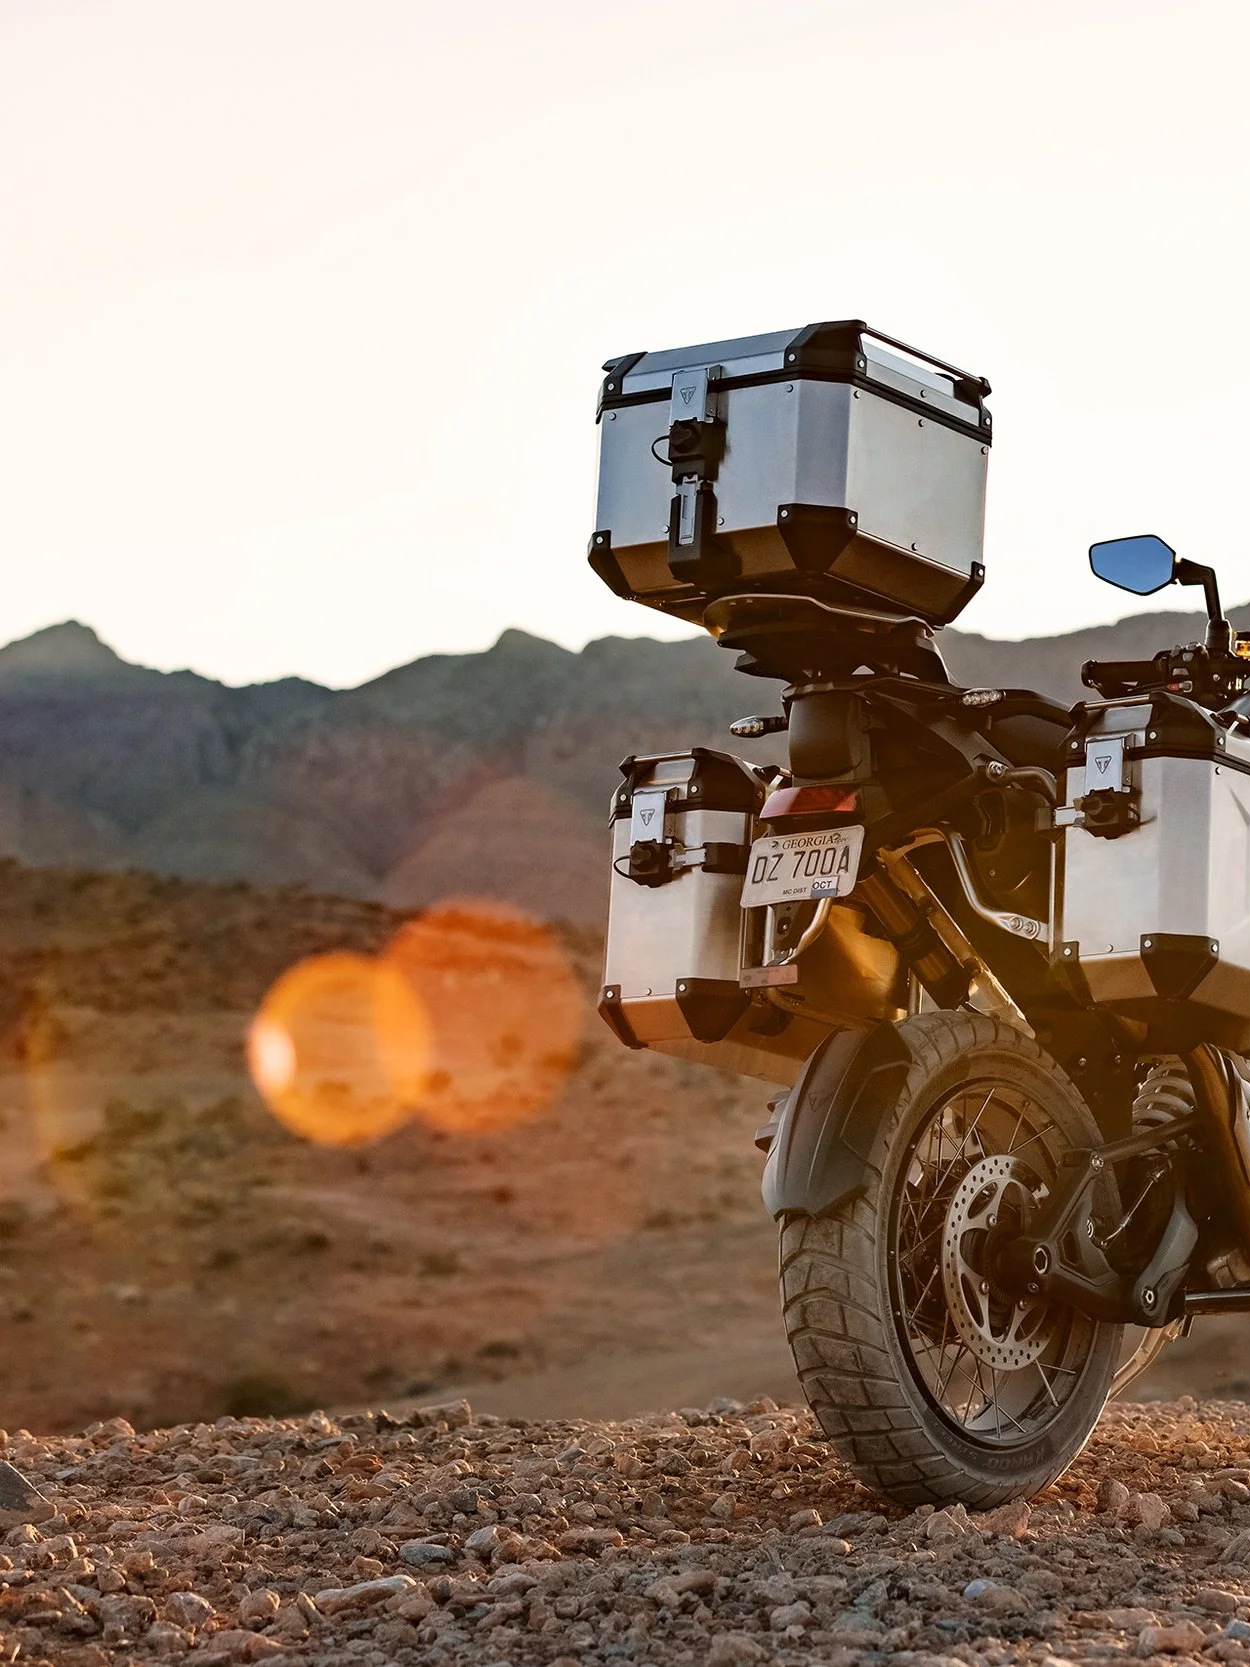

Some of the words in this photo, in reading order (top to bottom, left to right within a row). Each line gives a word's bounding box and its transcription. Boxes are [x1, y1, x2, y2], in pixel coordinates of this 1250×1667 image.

[782, 835, 834, 850] GEORGIA
[792, 845, 850, 879] 700A
[812, 880, 832, 890] OCT
[782, 888, 792, 896] MC
[793, 887, 807, 895] DIST
